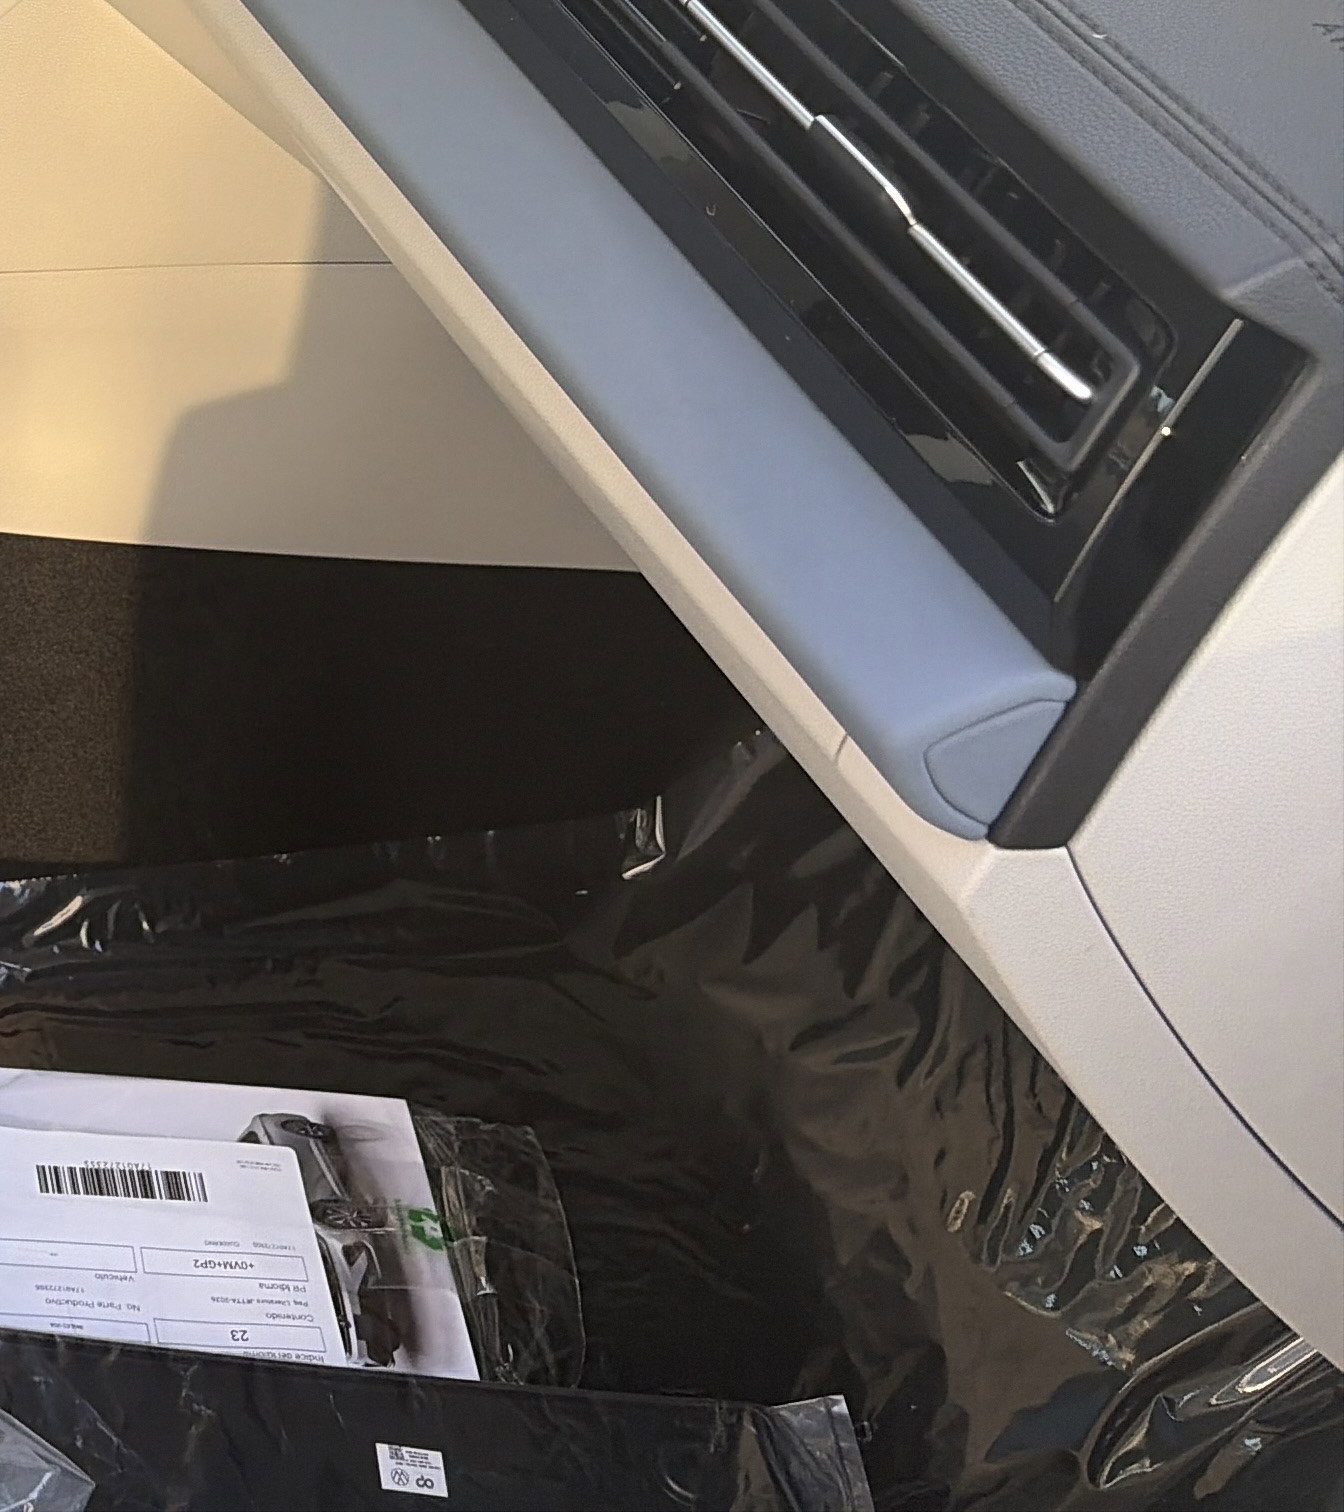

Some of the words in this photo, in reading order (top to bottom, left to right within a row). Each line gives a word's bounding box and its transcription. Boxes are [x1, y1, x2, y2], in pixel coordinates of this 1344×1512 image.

[193, 1259, 255, 1270] +0VM+GP2
[258, 1282, 291, 1292] Idioma
[292, 1285, 307, 1293] PR
[45, 1297, 96, 1309] Productivo
[97, 1302, 122, 1311] Parte
[265, 1312, 314, 1323] Contenido
[230, 1329, 249, 1342] 23
